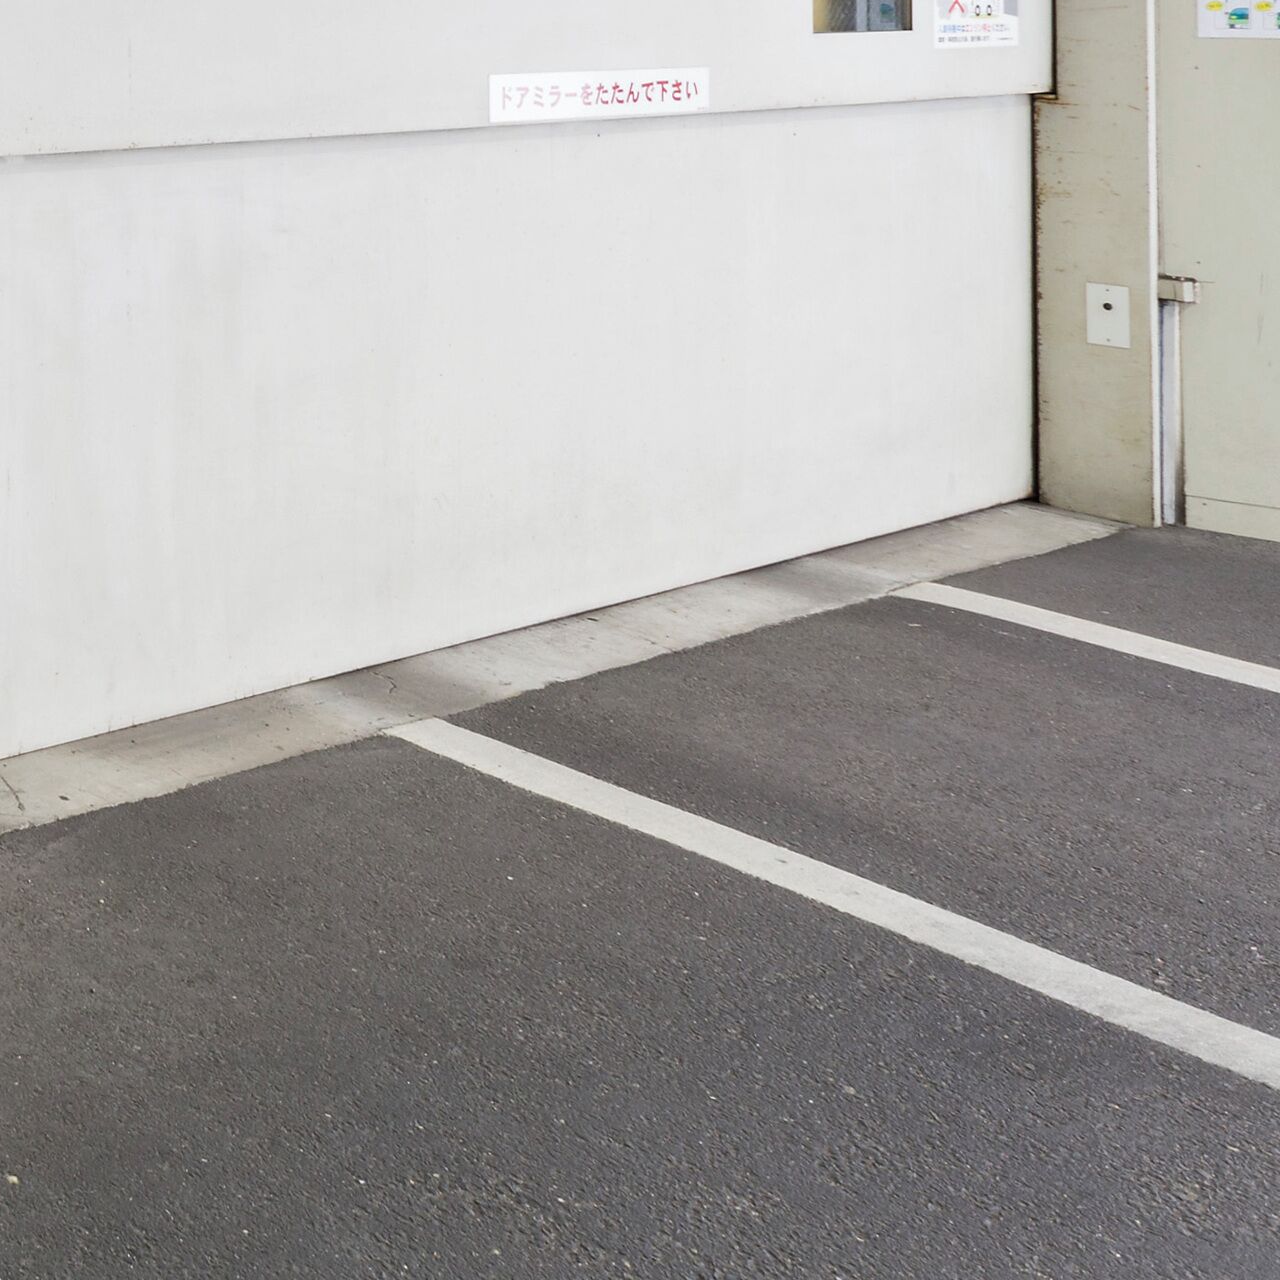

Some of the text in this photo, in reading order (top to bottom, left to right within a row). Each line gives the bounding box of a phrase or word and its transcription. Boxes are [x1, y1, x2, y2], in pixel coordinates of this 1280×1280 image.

[501, 80, 698, 110] ドアミラーをたたんで下さい
